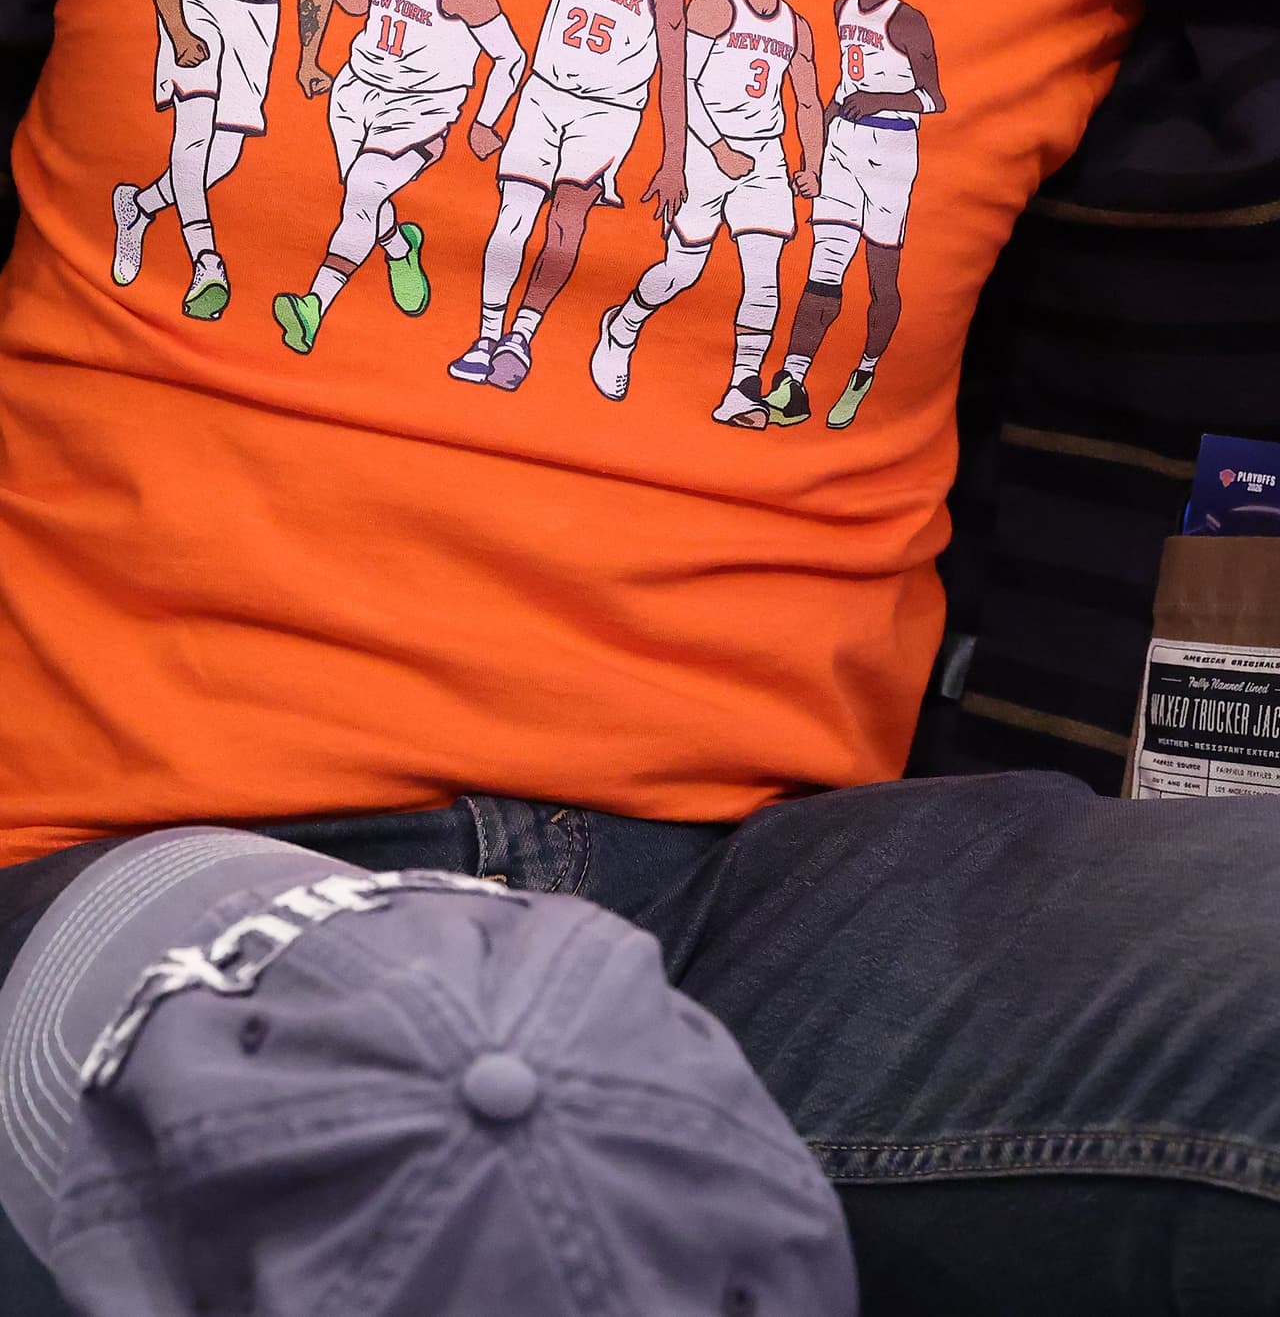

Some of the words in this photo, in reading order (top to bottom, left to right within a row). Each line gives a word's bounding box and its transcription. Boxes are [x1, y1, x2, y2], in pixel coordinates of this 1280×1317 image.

[377, 15, 408, 57] 11
[563, 6, 616, 55] 25
[857, 26, 884, 51] YORK
[727, 32, 761, 51] NEW
[761, 36, 793, 62] YORK
[745, 58, 770, 98] 3
[847, 45, 865, 81] 8
[1237, 471, 1276, 487] PLAYOFFS
[1183, 654, 1227, 665] AMERICAN
[1188, 675, 1210, 691] Fully
[1245, 681, 1270, 694] Lined
[1151, 693, 1190, 729] WAXED
[1192, 698, 1250, 736] TRUCKER
[1157, 738, 1245, 755] WEATHER-RESISTANT
